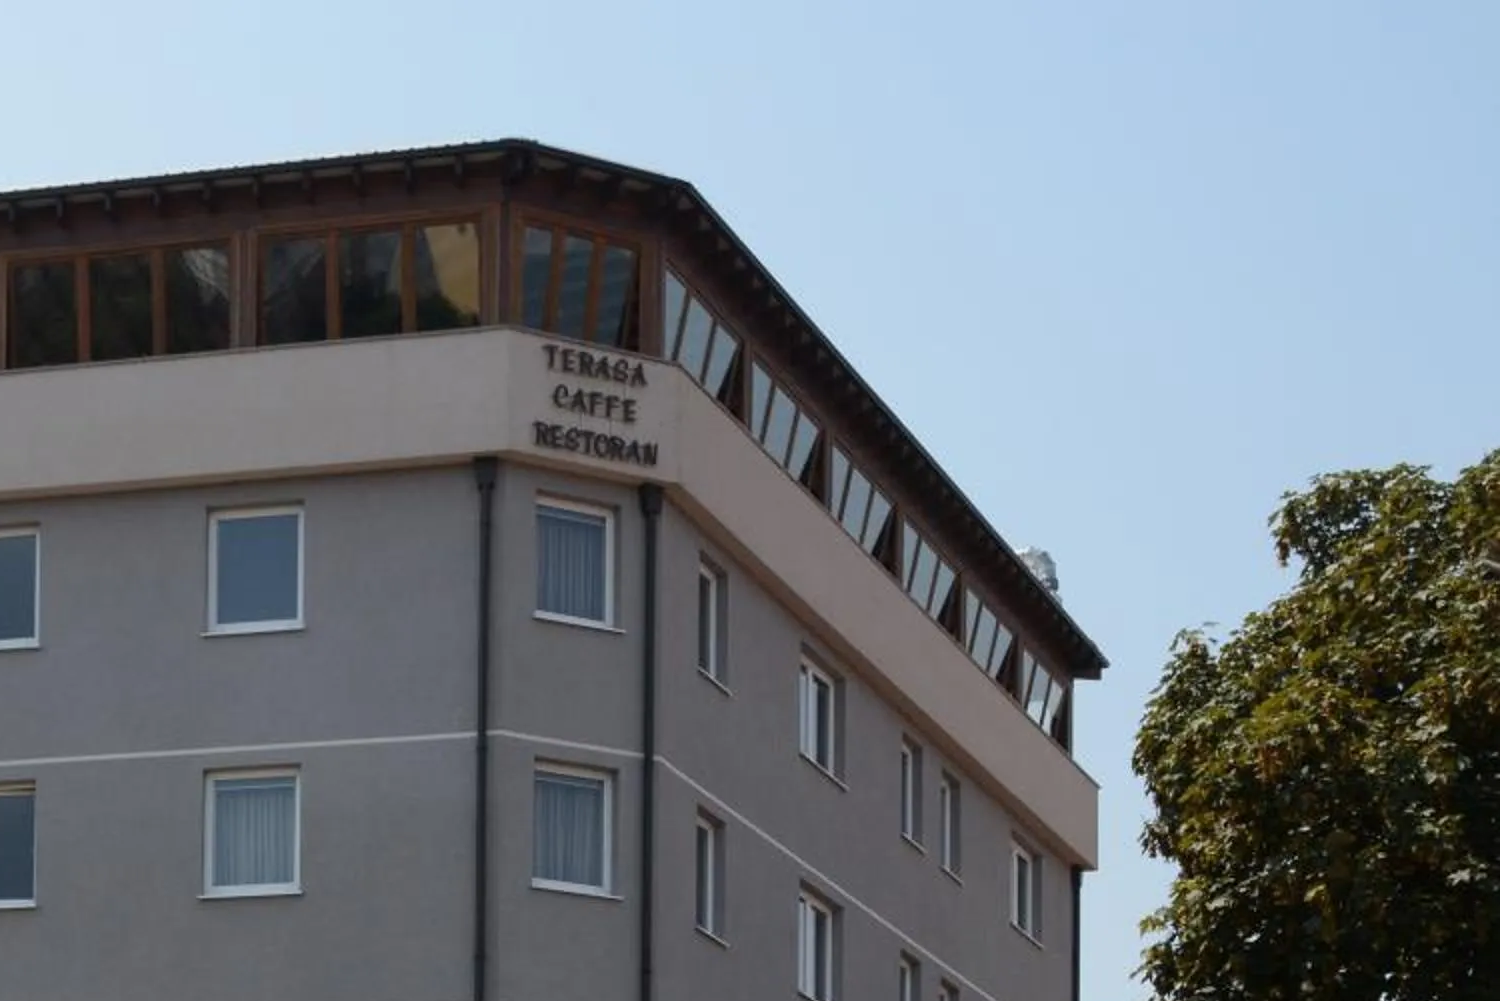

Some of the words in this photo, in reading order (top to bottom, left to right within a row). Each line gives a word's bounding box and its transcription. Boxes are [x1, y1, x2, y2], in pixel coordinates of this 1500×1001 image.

[542, 344, 647, 387] TERASA
[553, 384, 636, 423] CAFFE
[532, 421, 658, 466] RESTORAN
